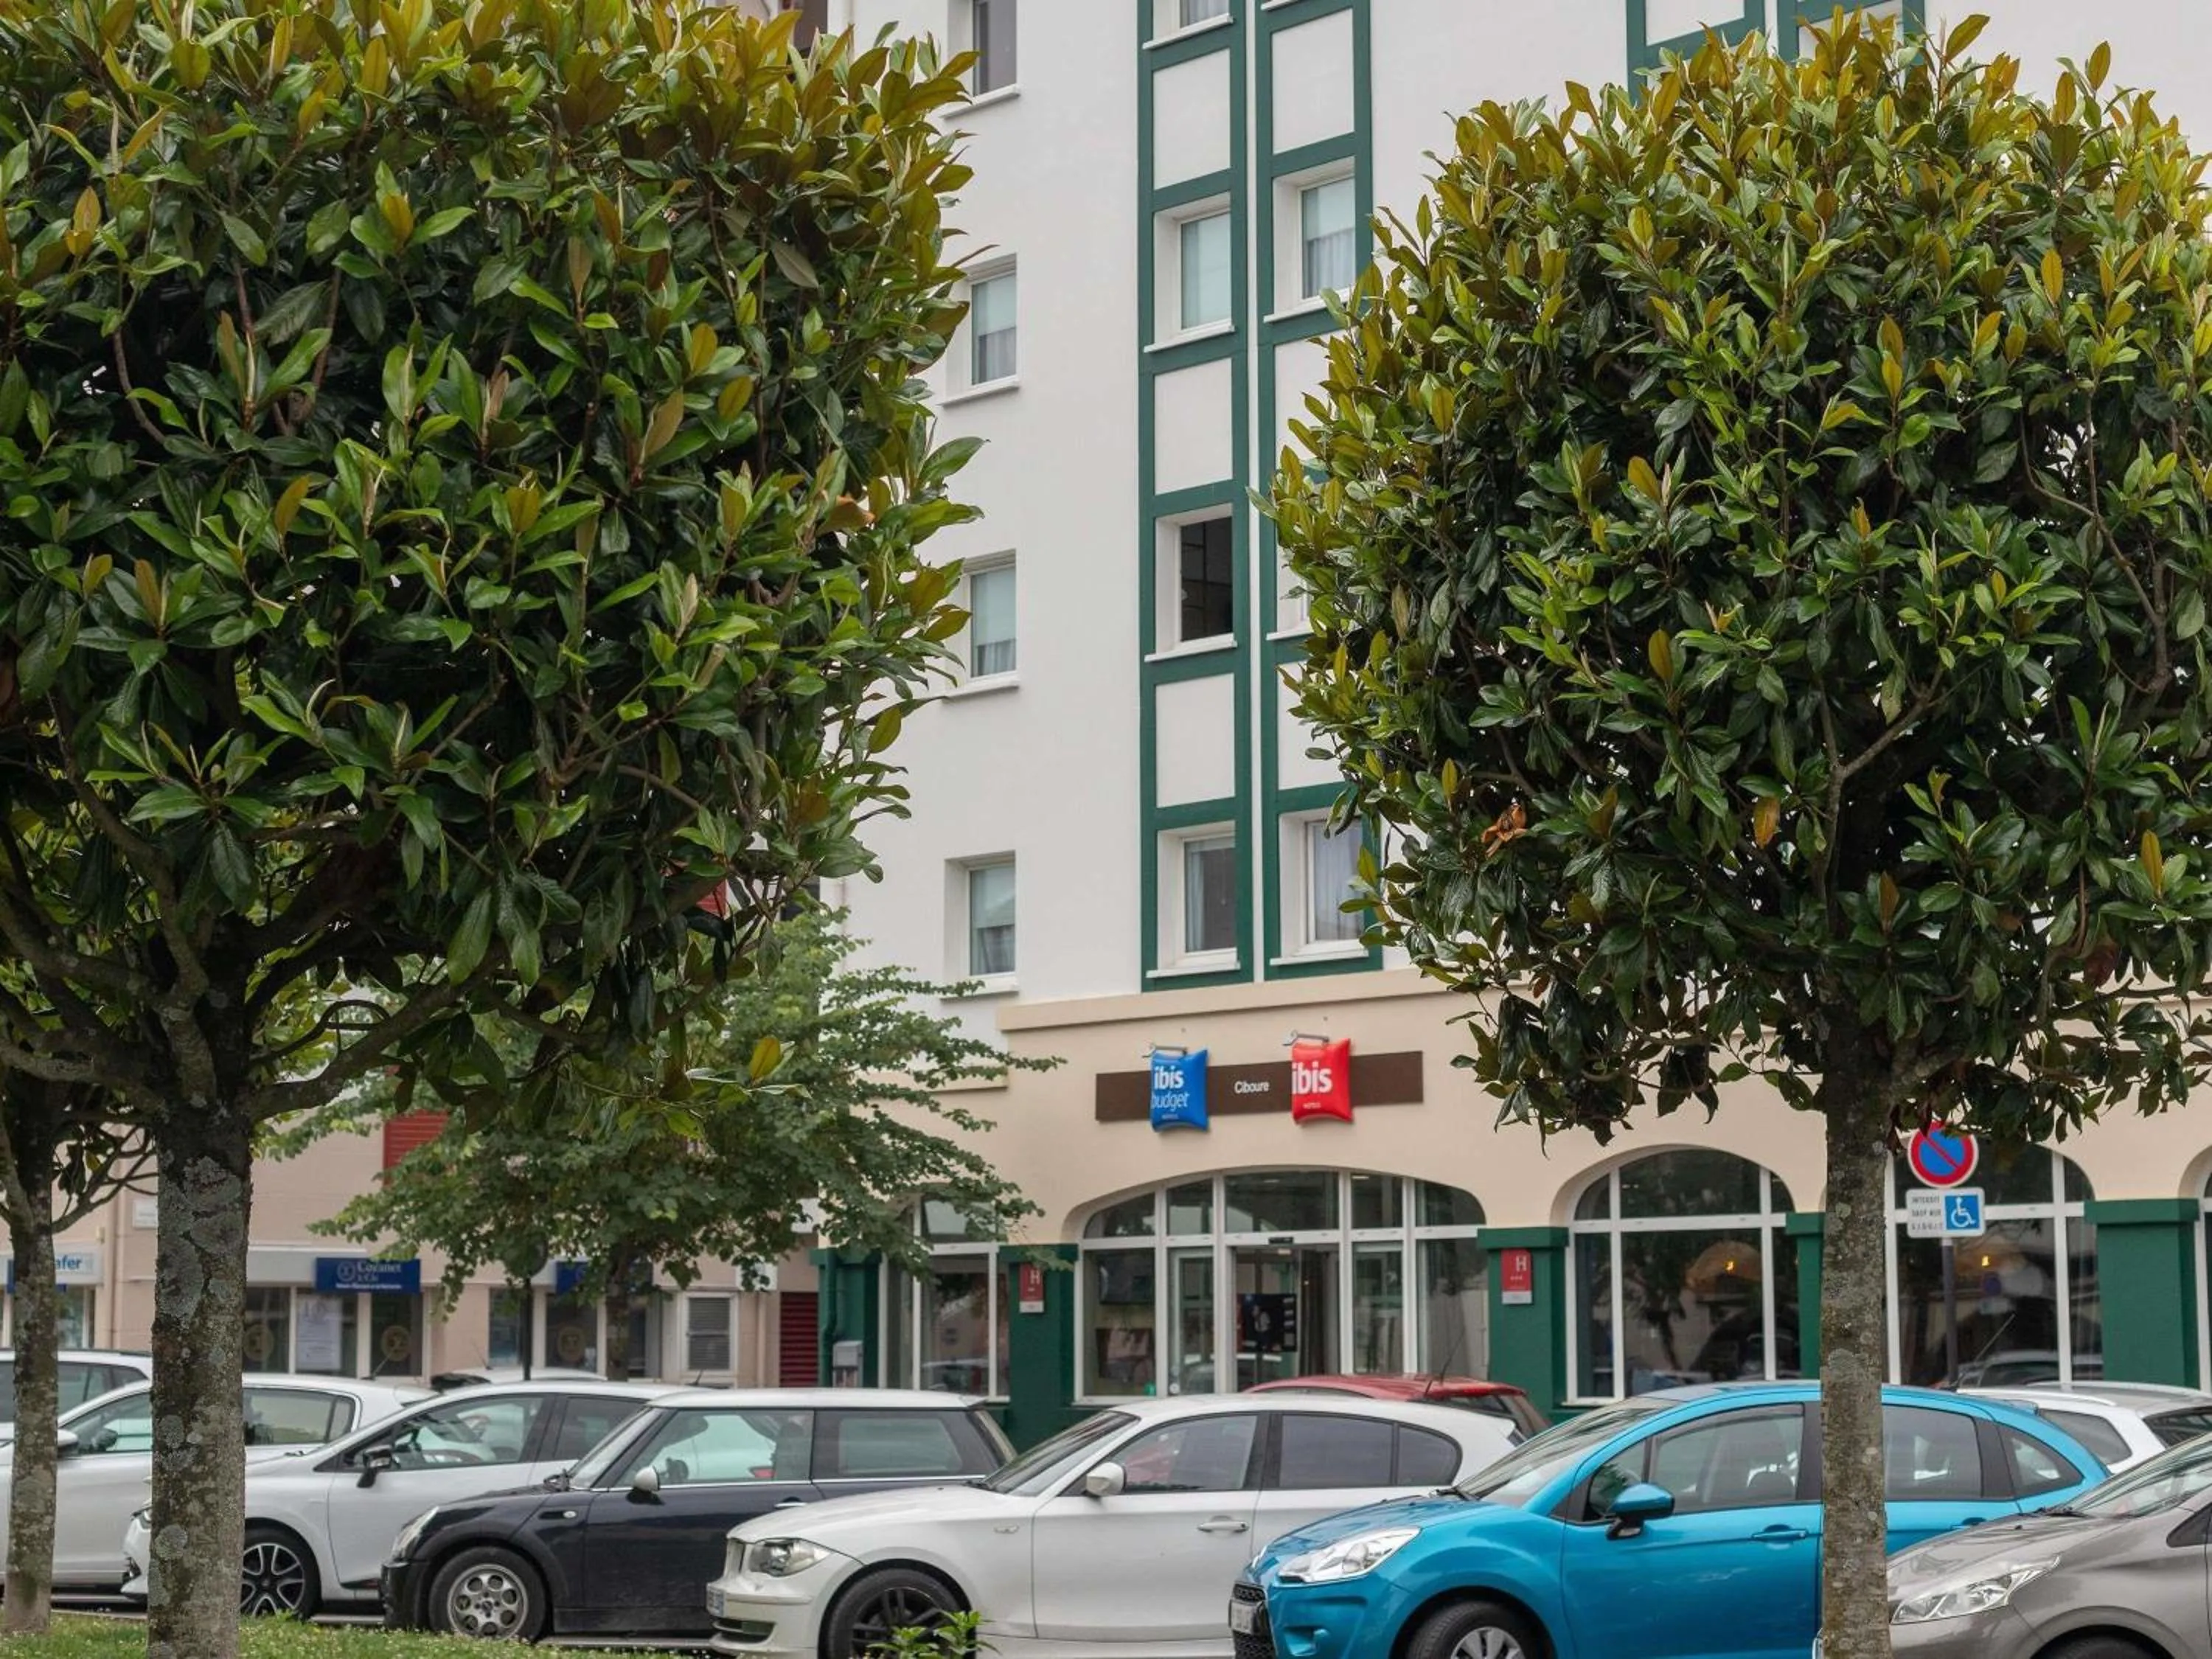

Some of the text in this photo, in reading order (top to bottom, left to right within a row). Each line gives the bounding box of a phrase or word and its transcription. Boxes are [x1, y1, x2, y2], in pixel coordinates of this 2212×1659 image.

[1154, 1065, 1184, 1090] ibis
[1292, 1060, 1332, 1095] ibis
[1234, 1080, 1270, 1094] Ciboure
[1516, 1255, 1526, 1272] H
[1030, 1269, 1040, 1284] H
